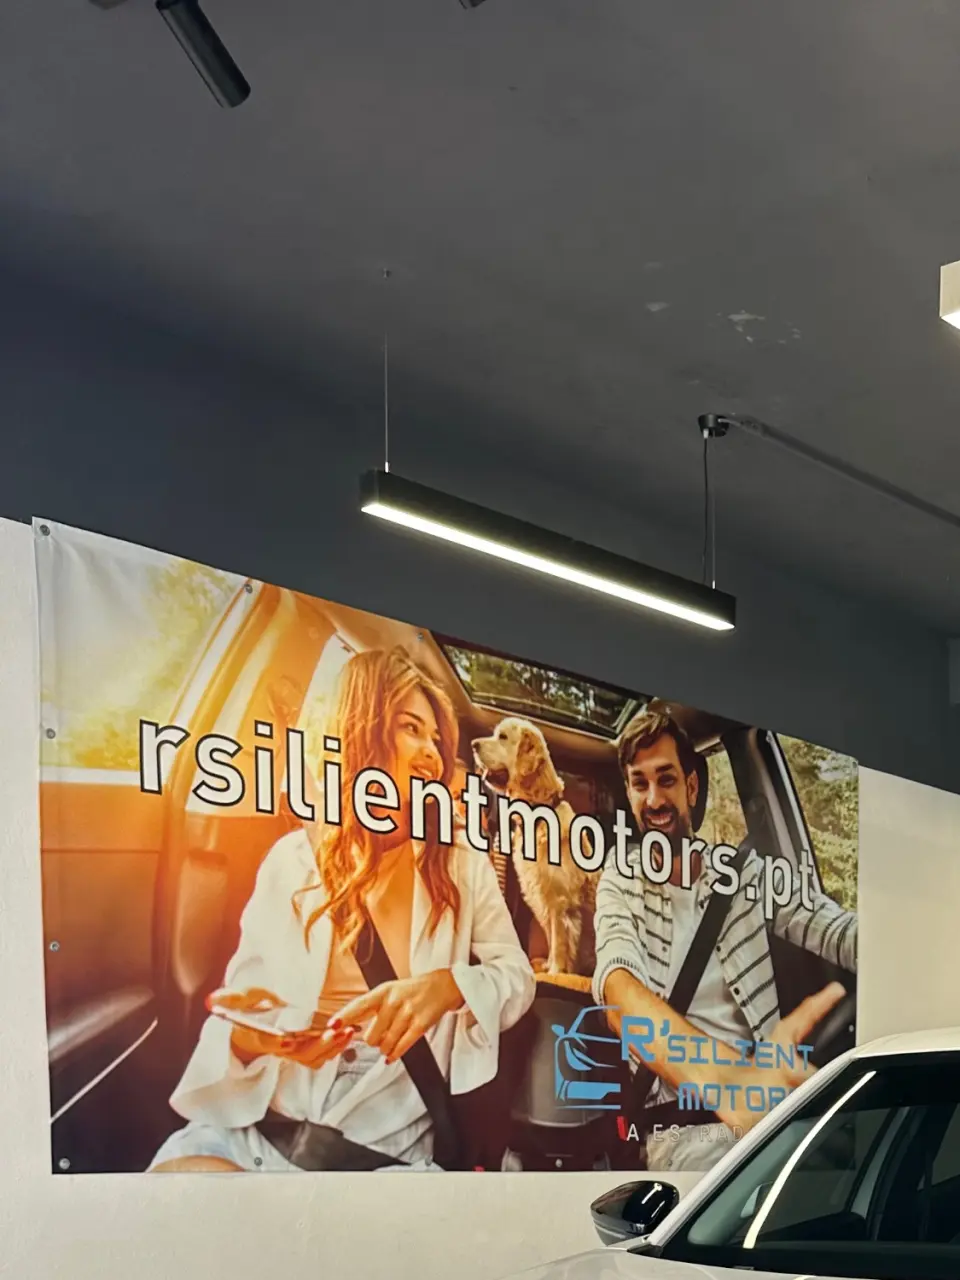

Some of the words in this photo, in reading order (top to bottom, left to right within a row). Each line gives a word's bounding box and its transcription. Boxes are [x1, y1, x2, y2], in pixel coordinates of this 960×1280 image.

[138, 719, 817, 920] rsilientmotors.pt
[621, 1016, 814, 1071] R'SILIENT
[678, 1082, 795, 1112] MOTOR
[626, 1123, 640, 1141] A
[653, 1123, 747, 1143] ESTRAD
